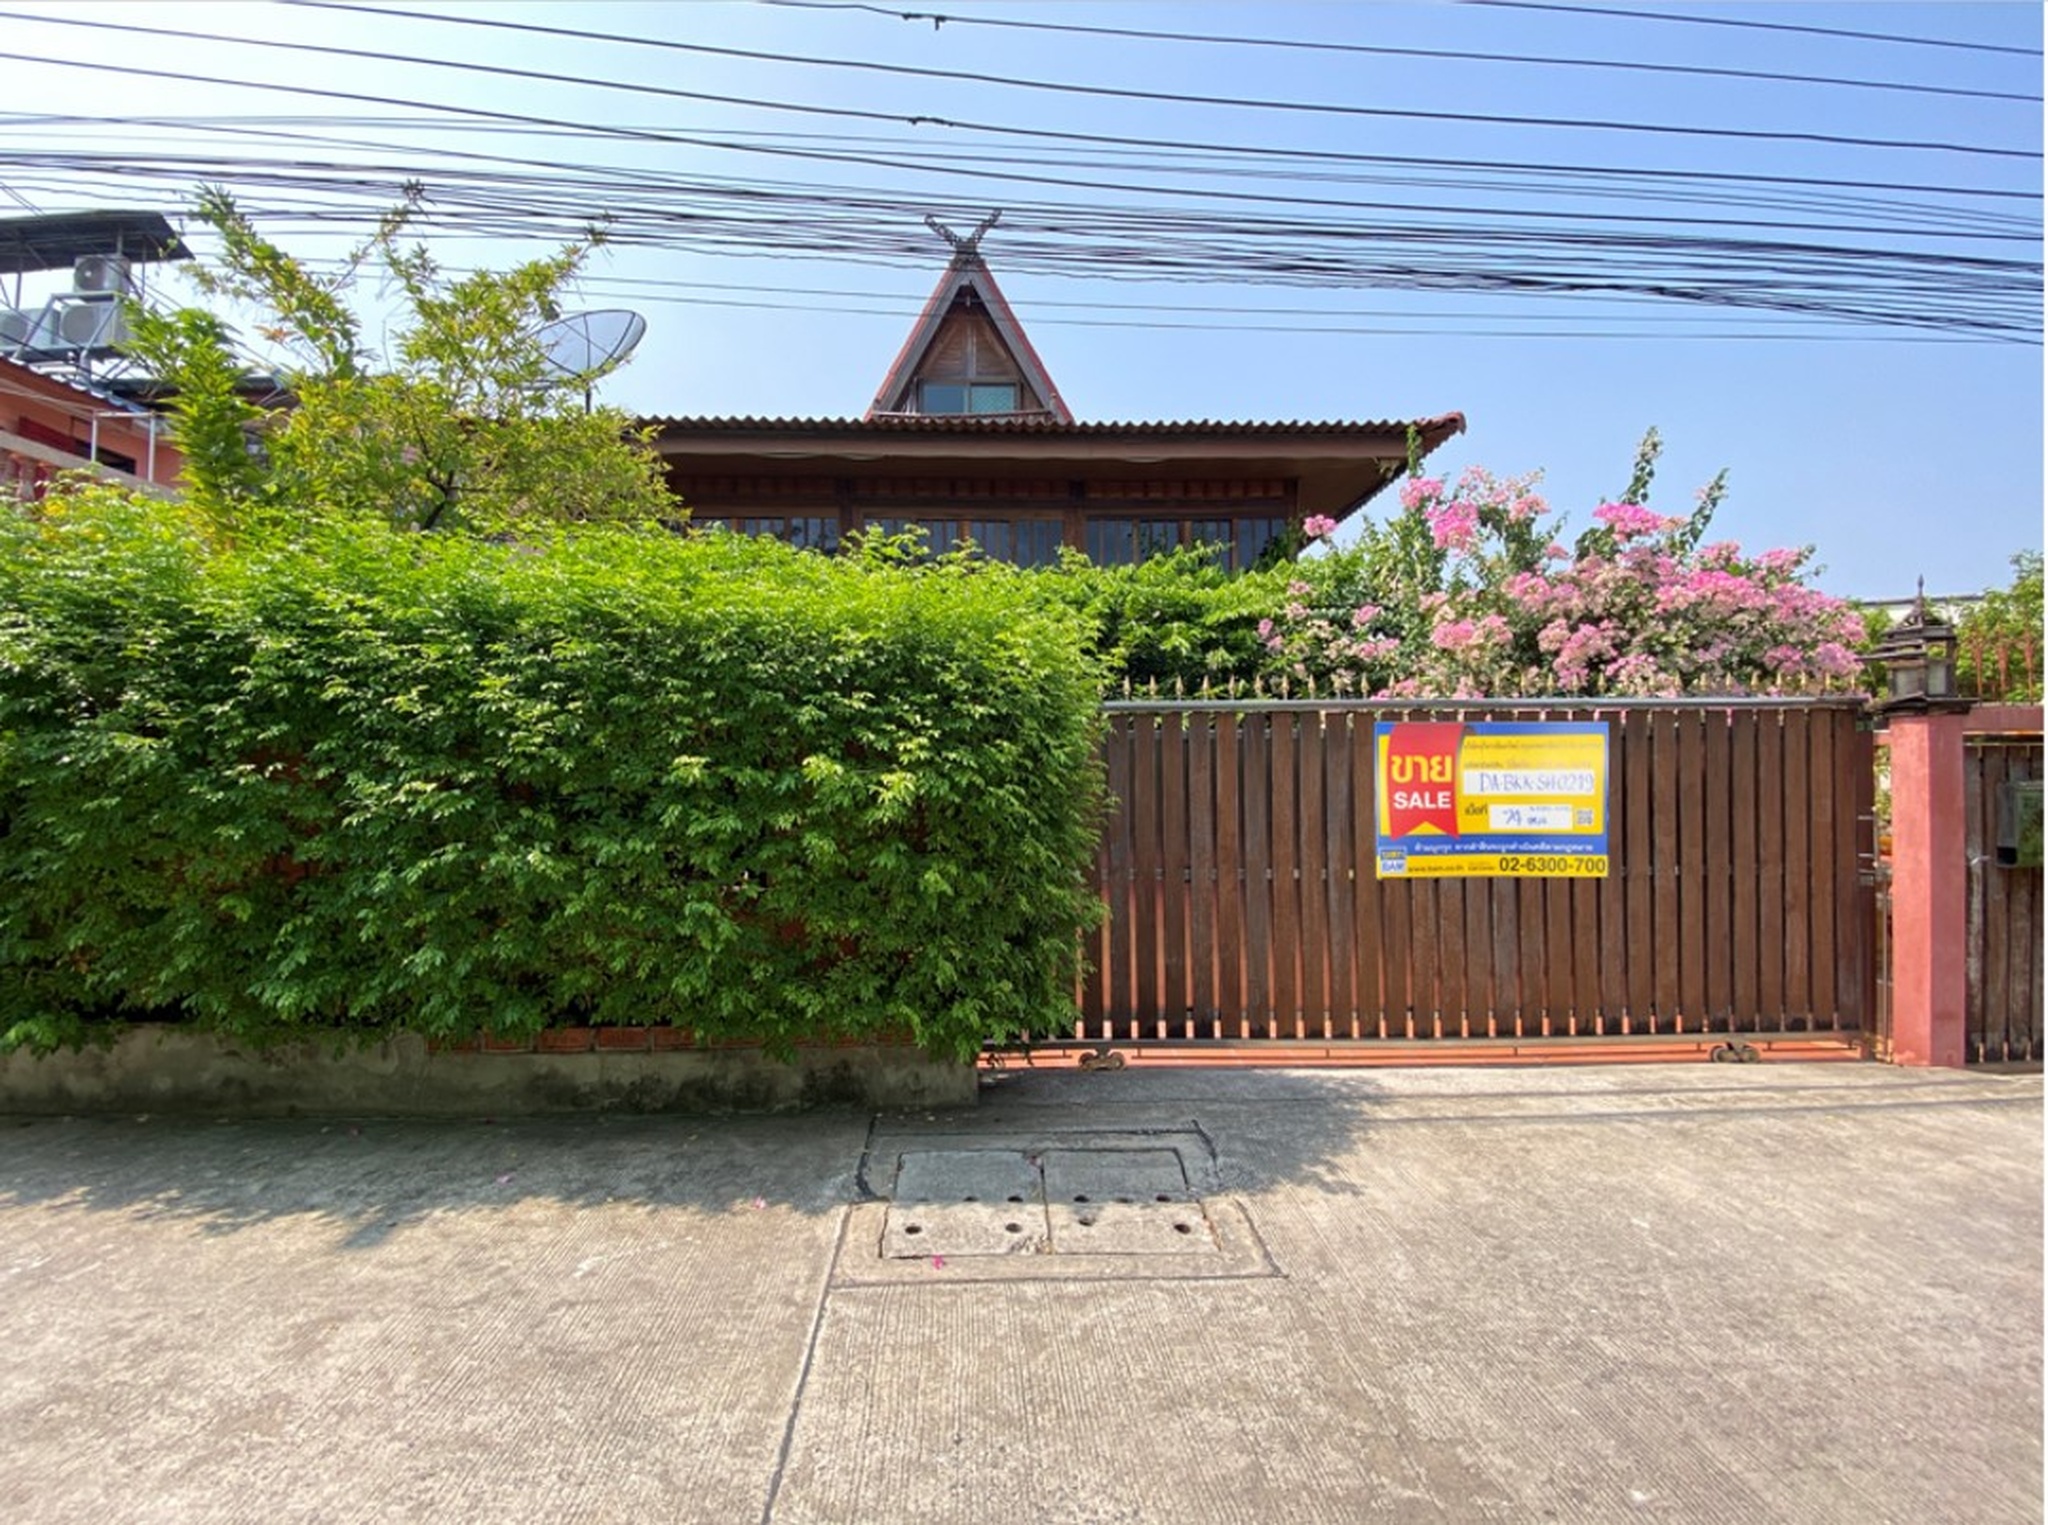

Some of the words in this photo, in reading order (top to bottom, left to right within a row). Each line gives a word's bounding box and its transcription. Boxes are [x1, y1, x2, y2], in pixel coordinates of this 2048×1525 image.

[1391, 755, 1452, 783] ขาย
[1393, 792, 1450, 809] SALE
[1499, 857, 1606, 873] 02-6300-700
